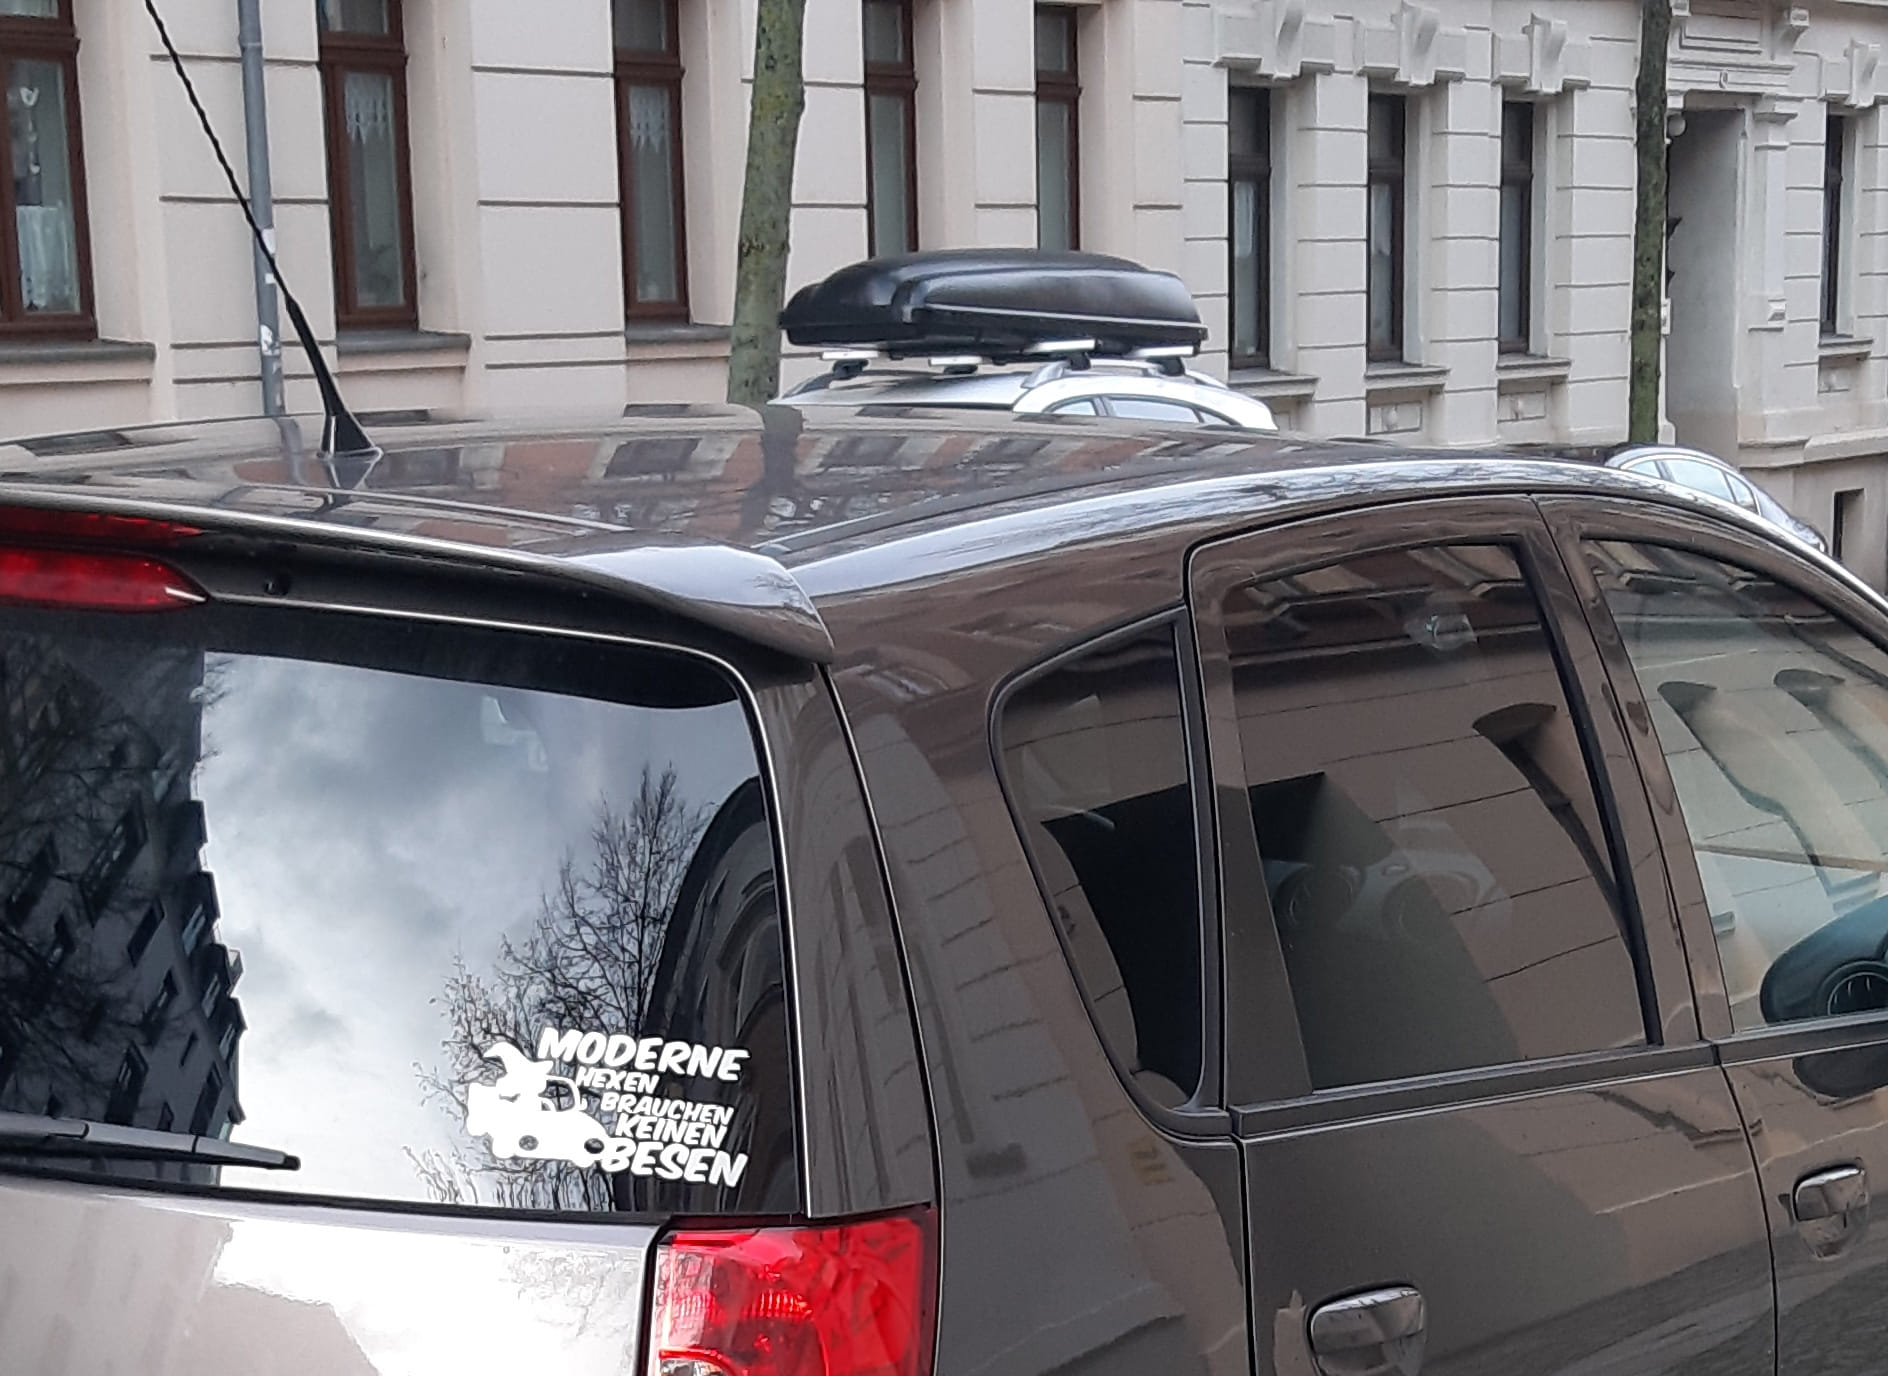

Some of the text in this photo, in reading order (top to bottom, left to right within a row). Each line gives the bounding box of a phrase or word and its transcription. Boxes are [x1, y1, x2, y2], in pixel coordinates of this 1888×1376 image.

[537, 1027, 750, 1081] MODERNE
[575, 1067, 660, 1094] HEXEN
[600, 1094, 734, 1126] BRAUCHEN
[615, 1112, 728, 1149] KEINEN
[601, 1137, 749, 1188] BESEN
